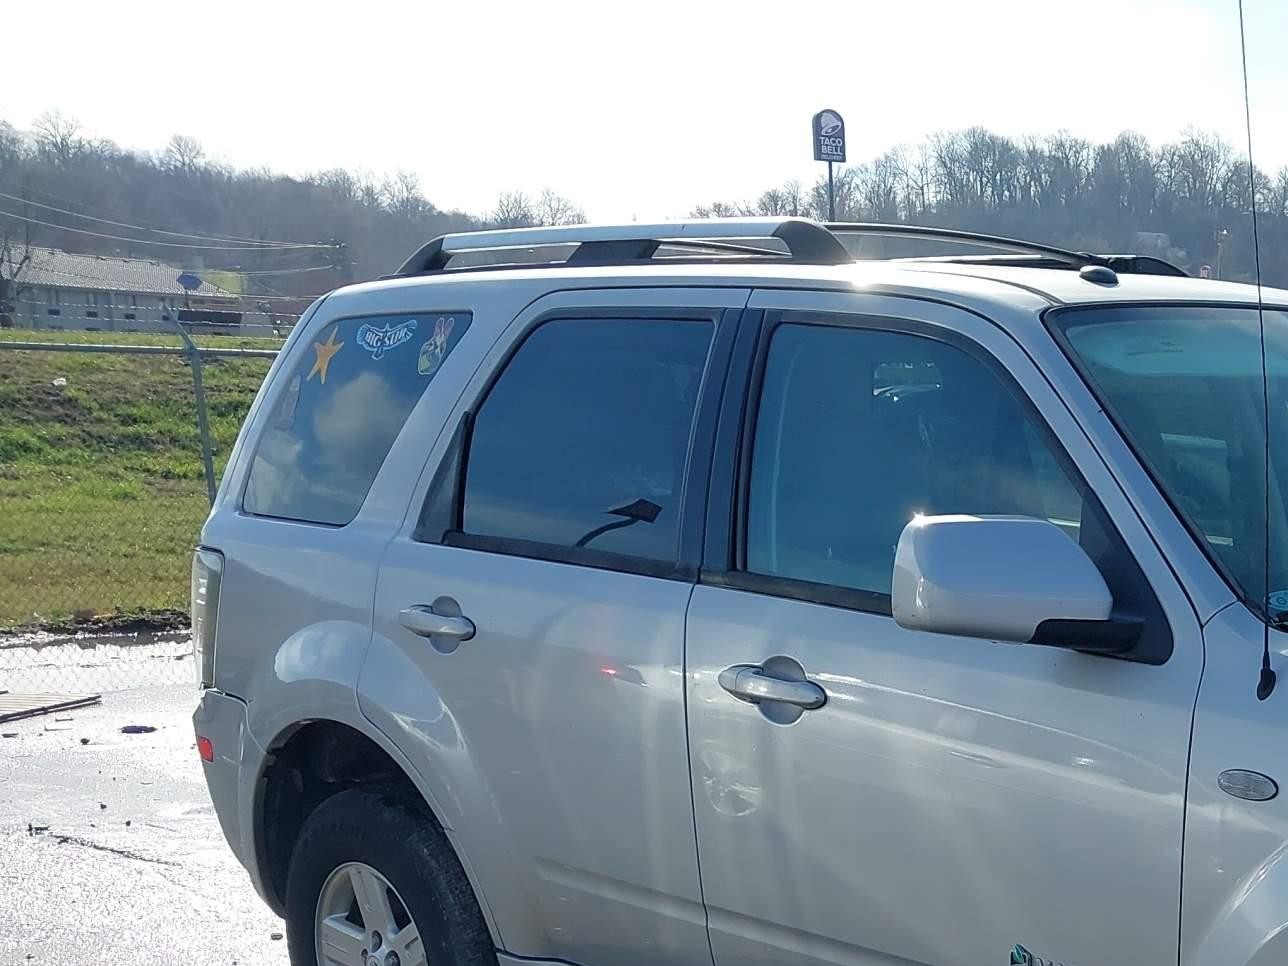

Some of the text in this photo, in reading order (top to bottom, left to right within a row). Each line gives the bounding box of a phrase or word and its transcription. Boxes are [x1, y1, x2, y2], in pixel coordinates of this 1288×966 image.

[819, 136, 843, 146] TACO
[821, 145, 844, 155] BELL
[364, 330, 383, 347] BIG
